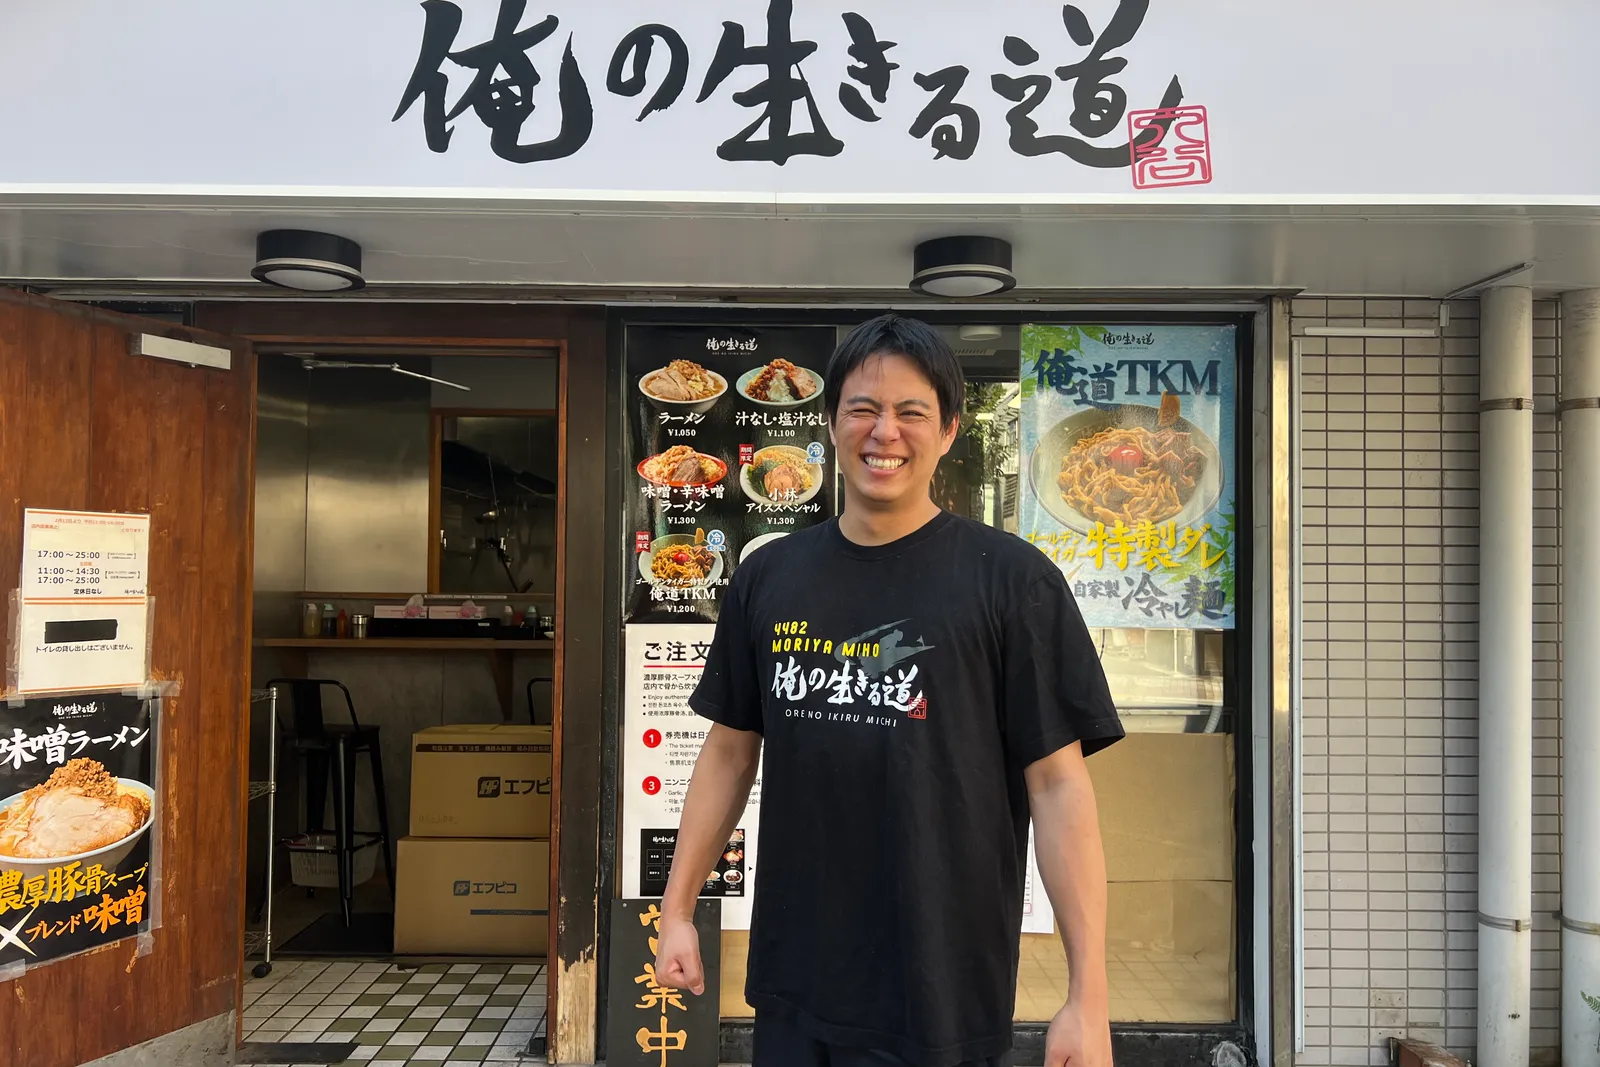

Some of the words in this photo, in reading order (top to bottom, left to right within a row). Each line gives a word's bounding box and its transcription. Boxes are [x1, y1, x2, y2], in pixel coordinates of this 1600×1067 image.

[392, 0, 1184, 167] 俺の生きる道
[1031, 347, 1221, 412] 俺道TKM
[659, 411, 706, 425] ラーメン
[768, 487, 799, 502] 小林
[660, 500, 706, 513] ラーメン
[745, 502, 821, 513] アイススペシャル
[710, 531, 722, 543] 冷
[1086, 519, 1227, 571] 特製ダレ
[649, 587, 716, 602] 俺道TKM
[773, 620, 809, 636] 4482
[644, 641, 713, 662] ご注文
[771, 637, 833, 655] MORIYA
[841, 642, 881, 658] MIHO
[770, 655, 924, 712] 俺の生きる道
[785, 708, 823, 720] ORENO
[827, 713, 860, 723] IKIRU
[865, 717, 897, 728] MICHI
[665, 731, 708, 740] 券売機は日
[0, 723, 150, 770] 味噌ラーメン
[472, 881, 517, 894] エフピコ
